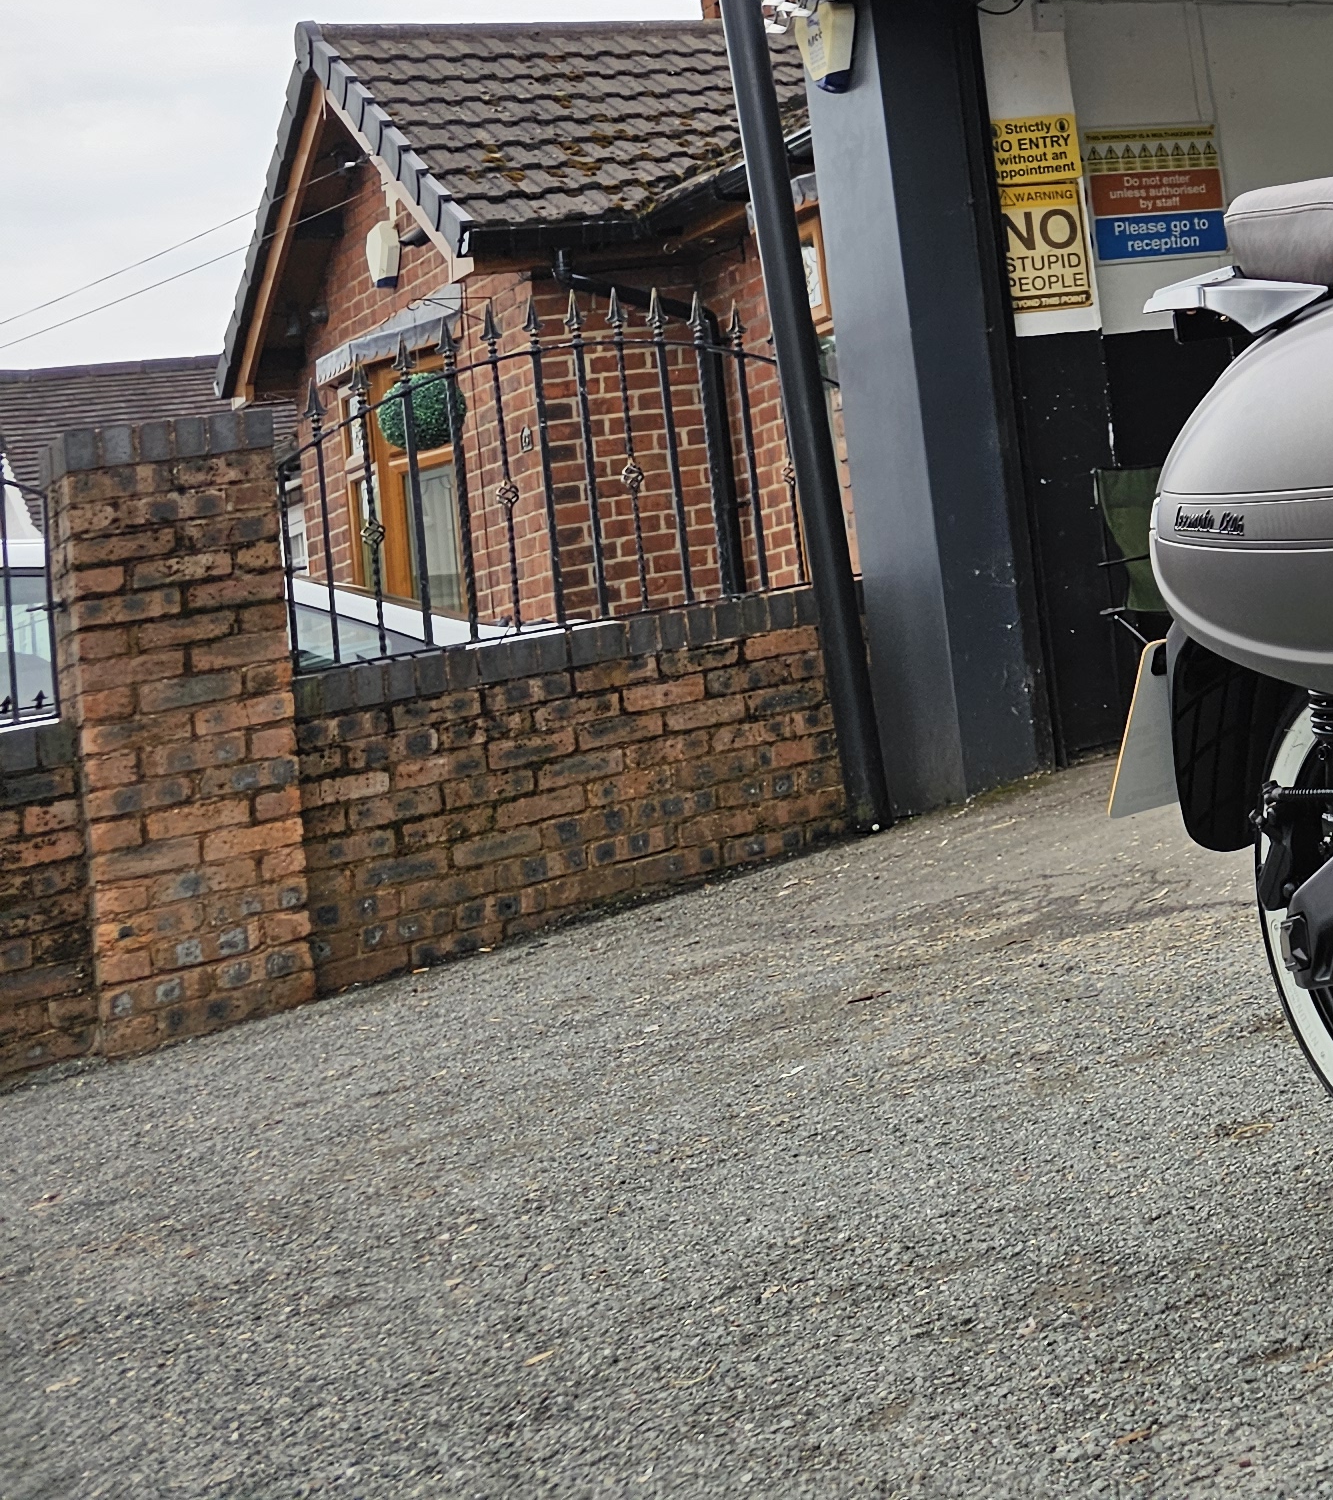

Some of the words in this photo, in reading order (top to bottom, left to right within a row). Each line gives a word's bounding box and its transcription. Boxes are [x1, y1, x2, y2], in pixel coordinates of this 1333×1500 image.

[1005, 121, 1052, 134] Strictly
[1017, 134, 1071, 151] ENTRY
[998, 152, 1048, 166] without
[1051, 151, 1068, 161] an
[1123, 176, 1139, 187] Do
[1142, 175, 1161, 186] not
[1162, 174, 1190, 185] enter
[1013, 189, 1073, 203] WARNING
[1109, 187, 1147, 199] unless
[1149, 184, 1206, 197] authorised
[1140, 198, 1153, 210] by
[1156, 196, 1180, 207] staff
[1001, 208, 1078, 253] NO
[1114, 221, 1167, 236] Please
[1170, 220, 1190, 235] go
[1194, 217, 1209, 230] to
[1127, 235, 1200, 252] reception
[1006, 252, 1082, 274] STUPID
